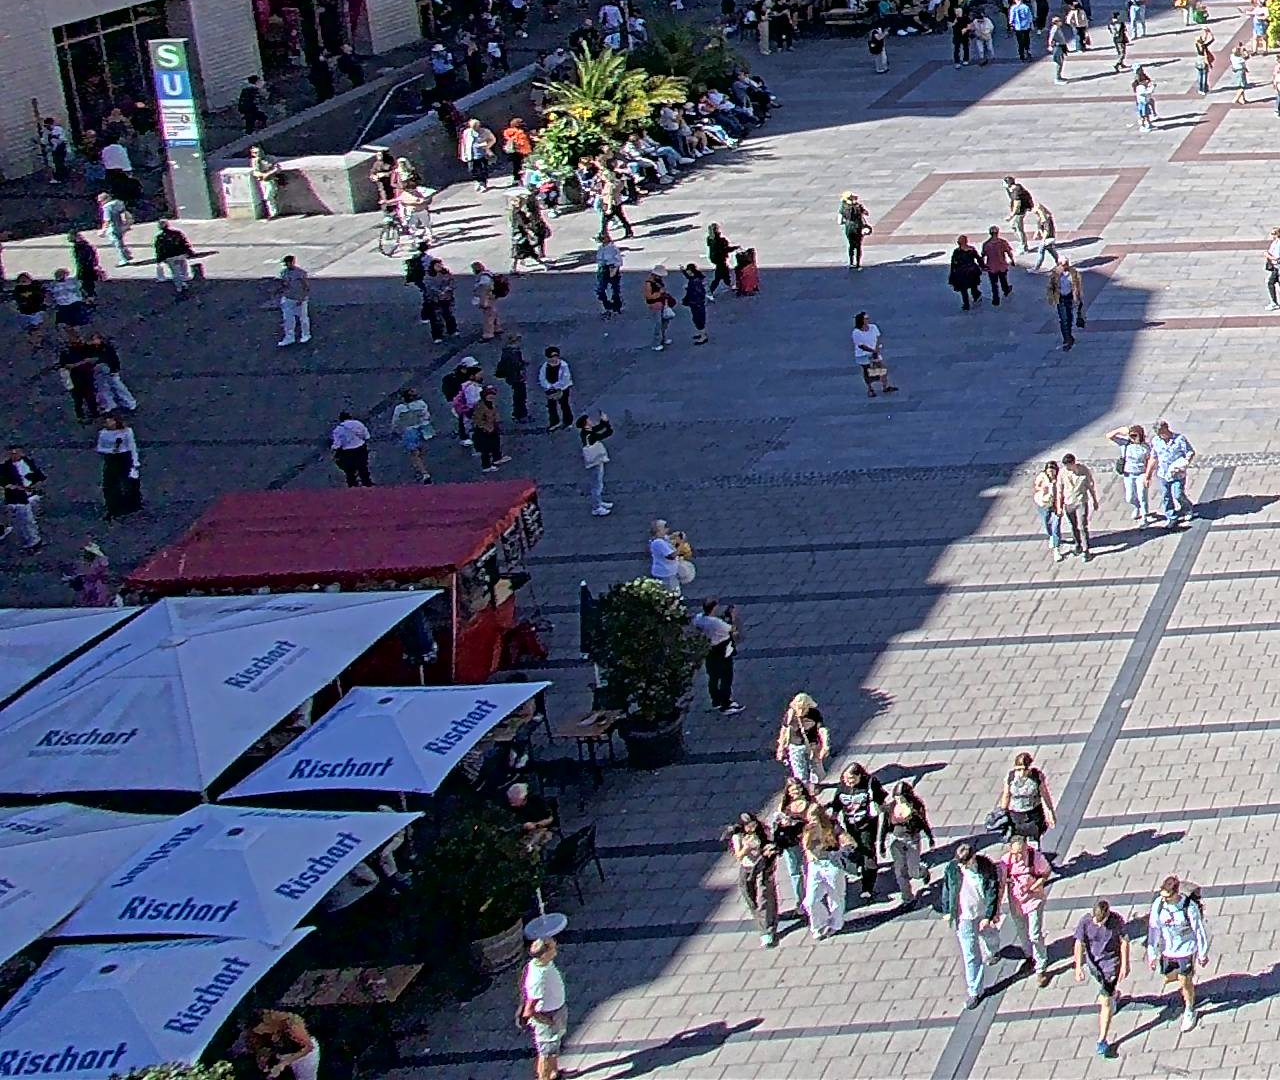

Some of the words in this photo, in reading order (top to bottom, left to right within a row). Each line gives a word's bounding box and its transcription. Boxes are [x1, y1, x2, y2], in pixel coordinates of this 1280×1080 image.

[157, 44, 180, 67] S
[163, 74, 183, 96] U
[224, 639, 297, 689] Rischart
[36, 728, 139, 747] Rischart
[424, 699, 499, 756] Rischart
[288, 756, 395, 780] Rischart
[274, 831, 363, 900] Rischart
[118, 895, 240, 923] Rischart
[163, 955, 251, 1035] Rischart
[0, 1042, 127, 1077] Rischart
